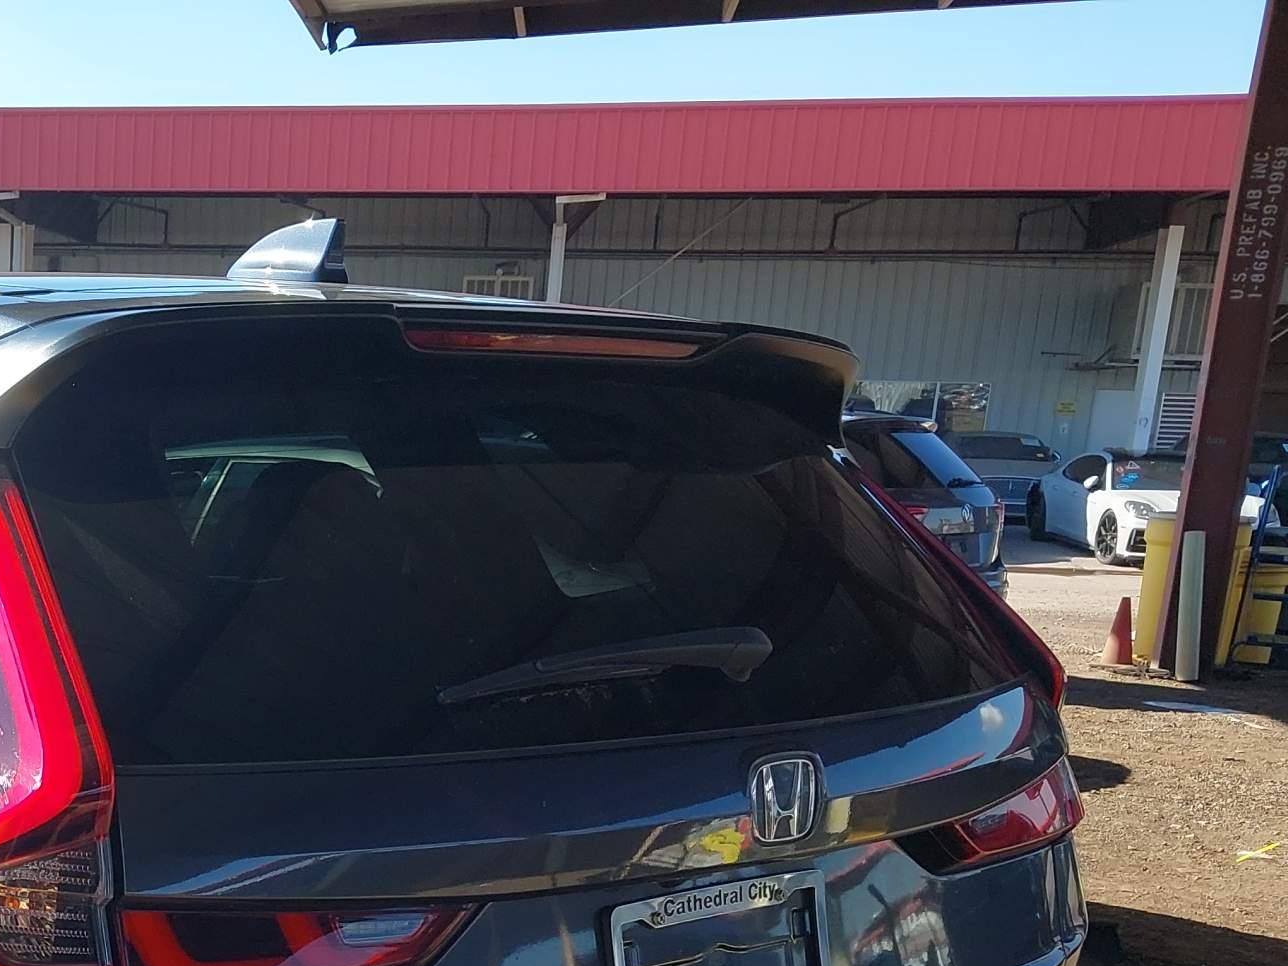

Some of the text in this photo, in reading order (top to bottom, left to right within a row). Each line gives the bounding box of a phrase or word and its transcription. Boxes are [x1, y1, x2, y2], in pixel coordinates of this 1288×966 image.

[1236, 189, 1262, 257] PREFAB
[1230, 268, 1249, 300] U.S.
[663, 881, 777, 918] Cathedral City
